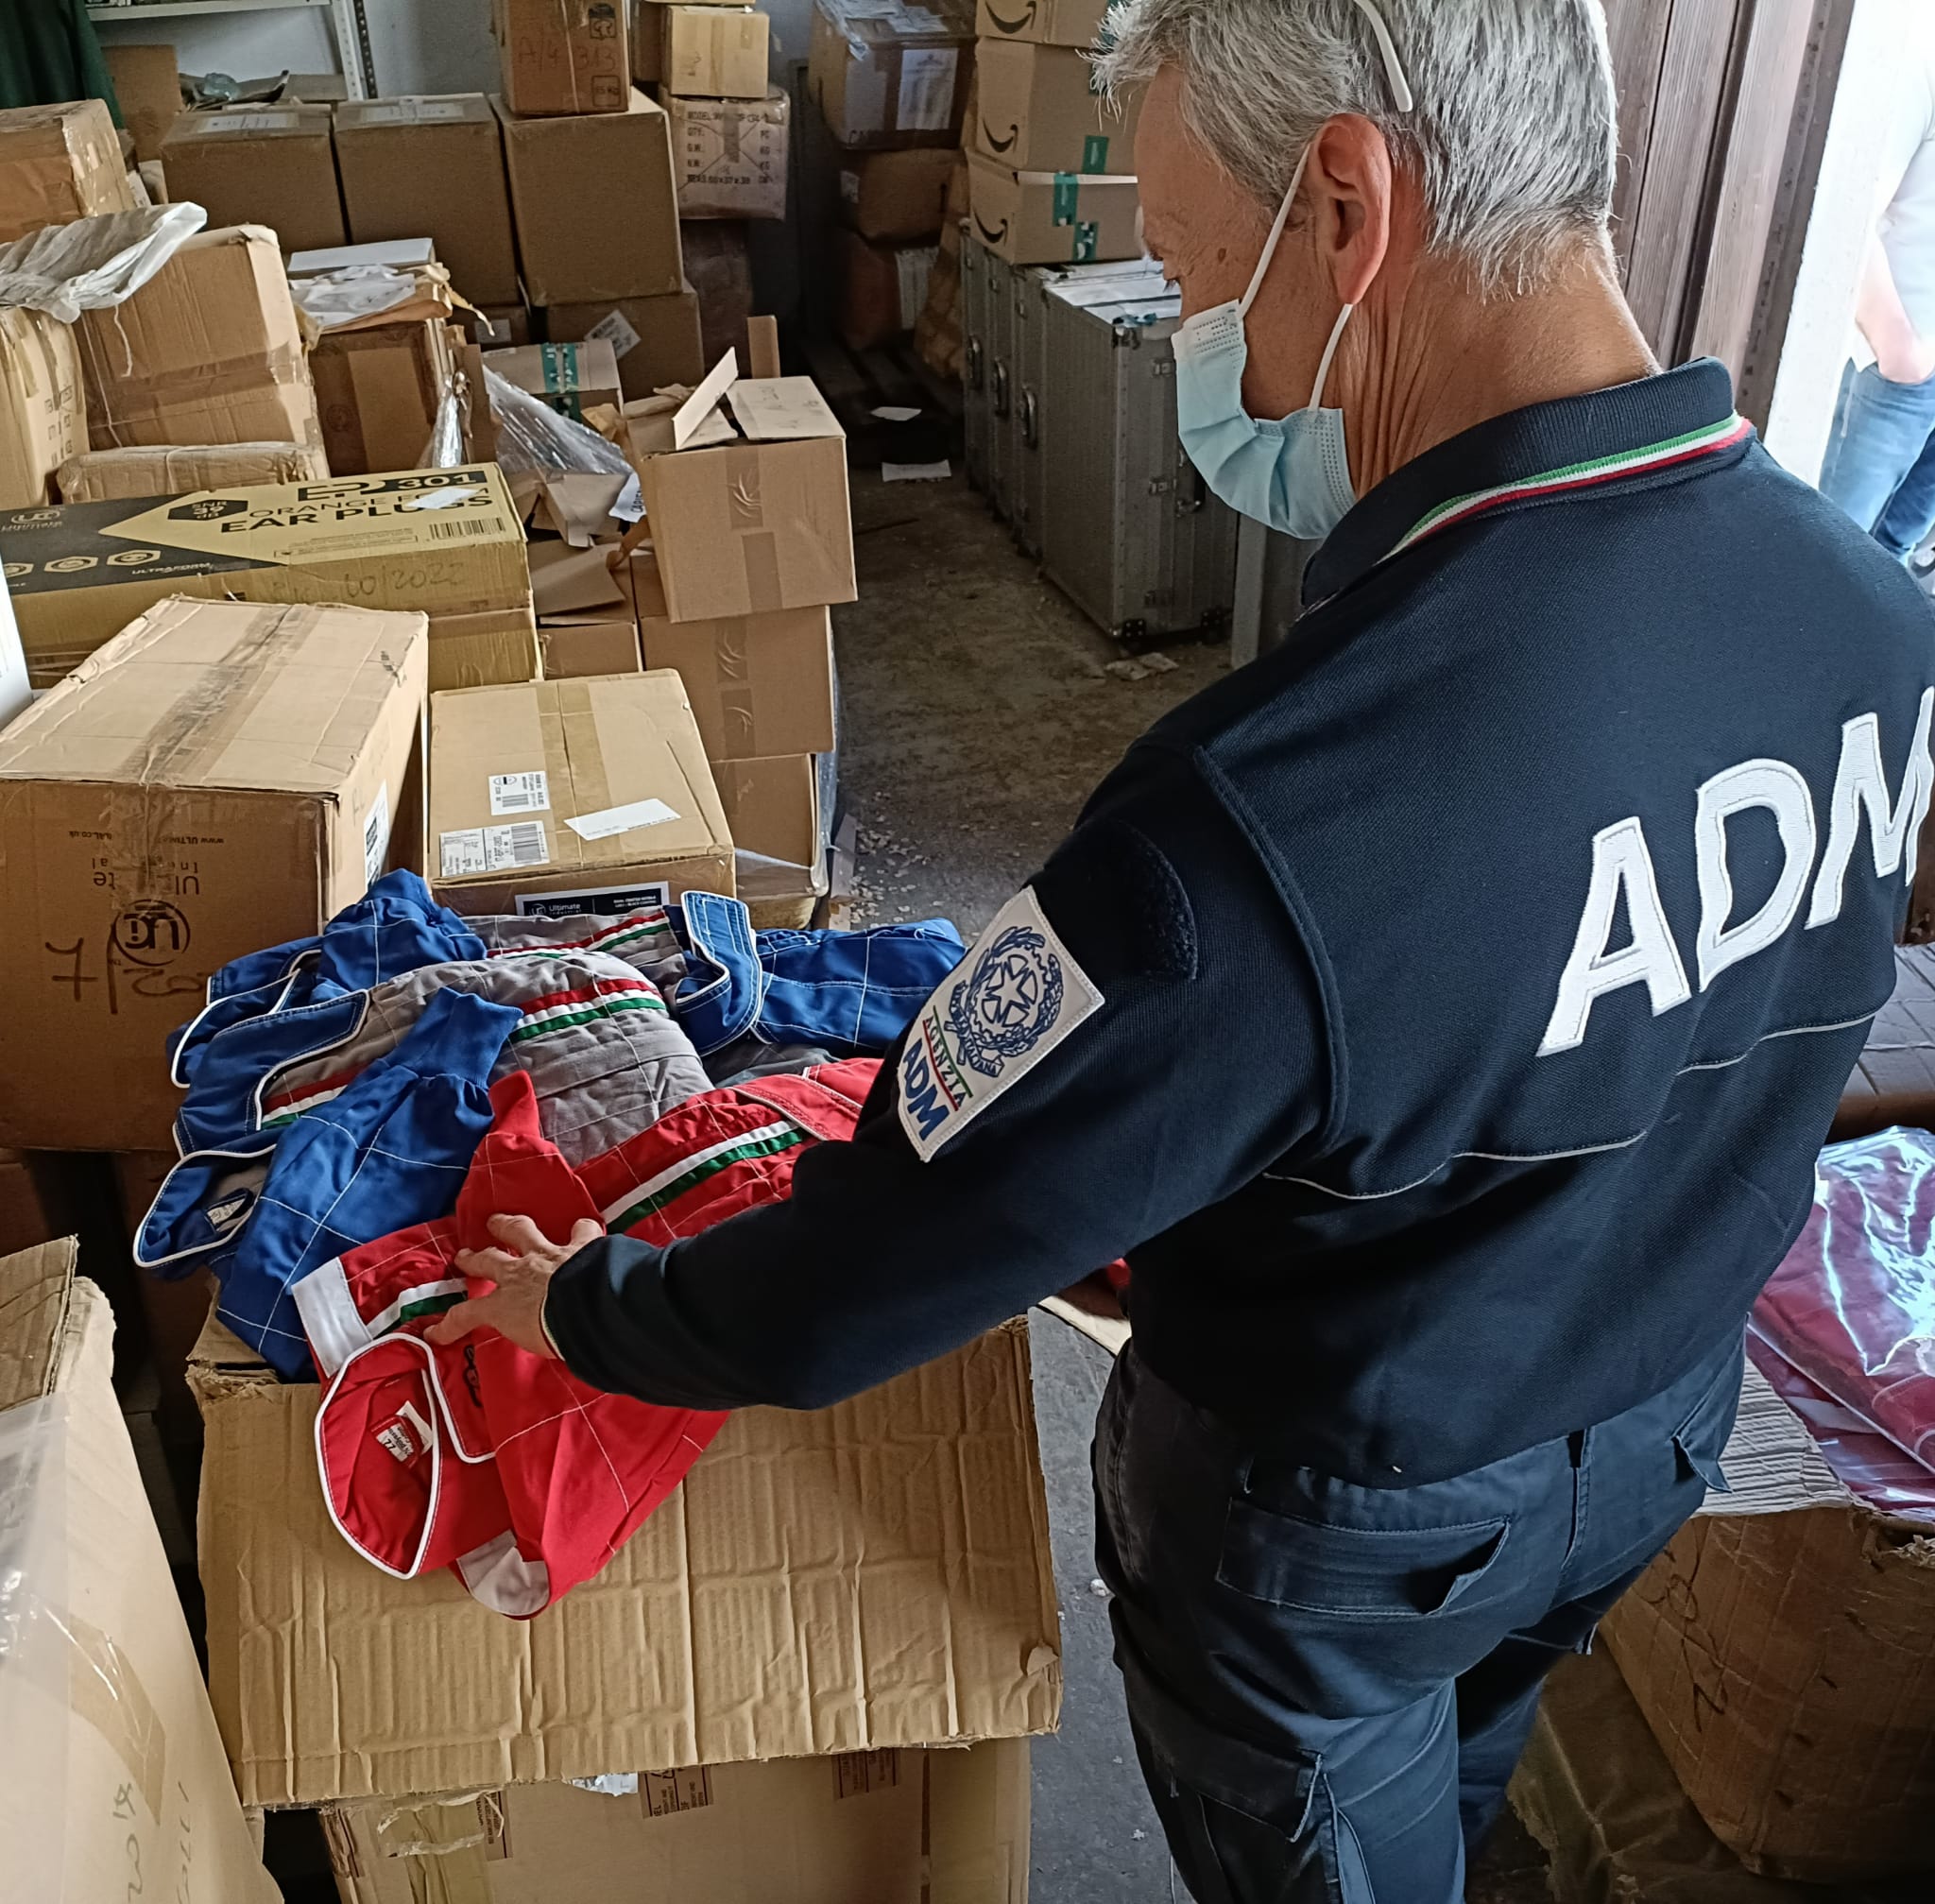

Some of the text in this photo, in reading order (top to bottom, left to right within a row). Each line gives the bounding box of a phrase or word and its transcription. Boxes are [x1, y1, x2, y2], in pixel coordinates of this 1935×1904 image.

[397, 473, 477, 489] 301
[249, 497, 386, 518] ORANGE
[221, 513, 319, 533] EAR
[1535, 685, 1935, 1056] ADM
[549, 903, 581, 912] Ultimate
[925, 1015, 967, 1108] AGENZIA
[903, 1037, 950, 1141] ADM
